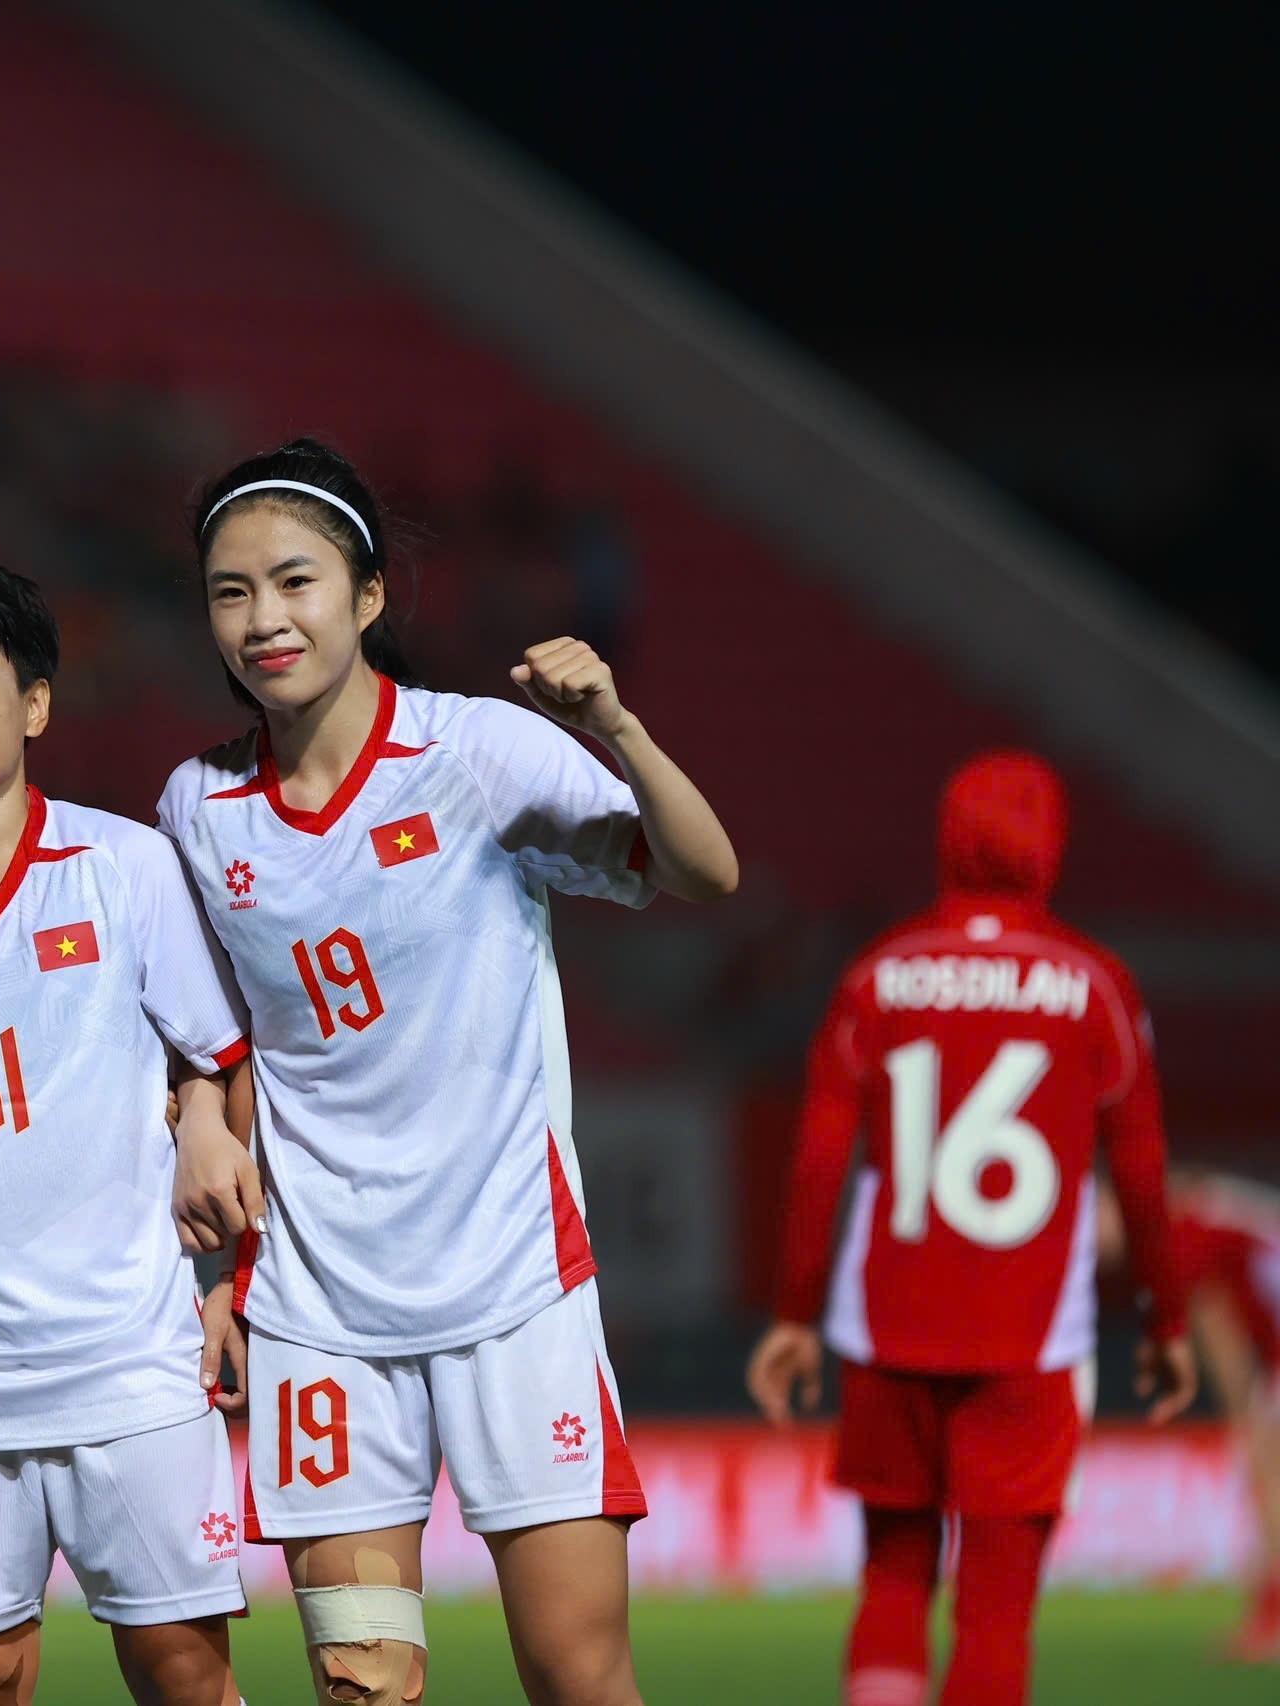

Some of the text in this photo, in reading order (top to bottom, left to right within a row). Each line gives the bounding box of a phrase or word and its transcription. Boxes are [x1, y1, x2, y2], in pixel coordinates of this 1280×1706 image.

[229, 899, 258, 911] JOGARBOLA
[291, 926, 385, 1040] 19
[885, 1036, 1060, 1247] 16
[277, 1376, 351, 1488] 19
[552, 1452, 590, 1464] JOGARBOLA
[208, 1548, 240, 1563] JOGARBOL
